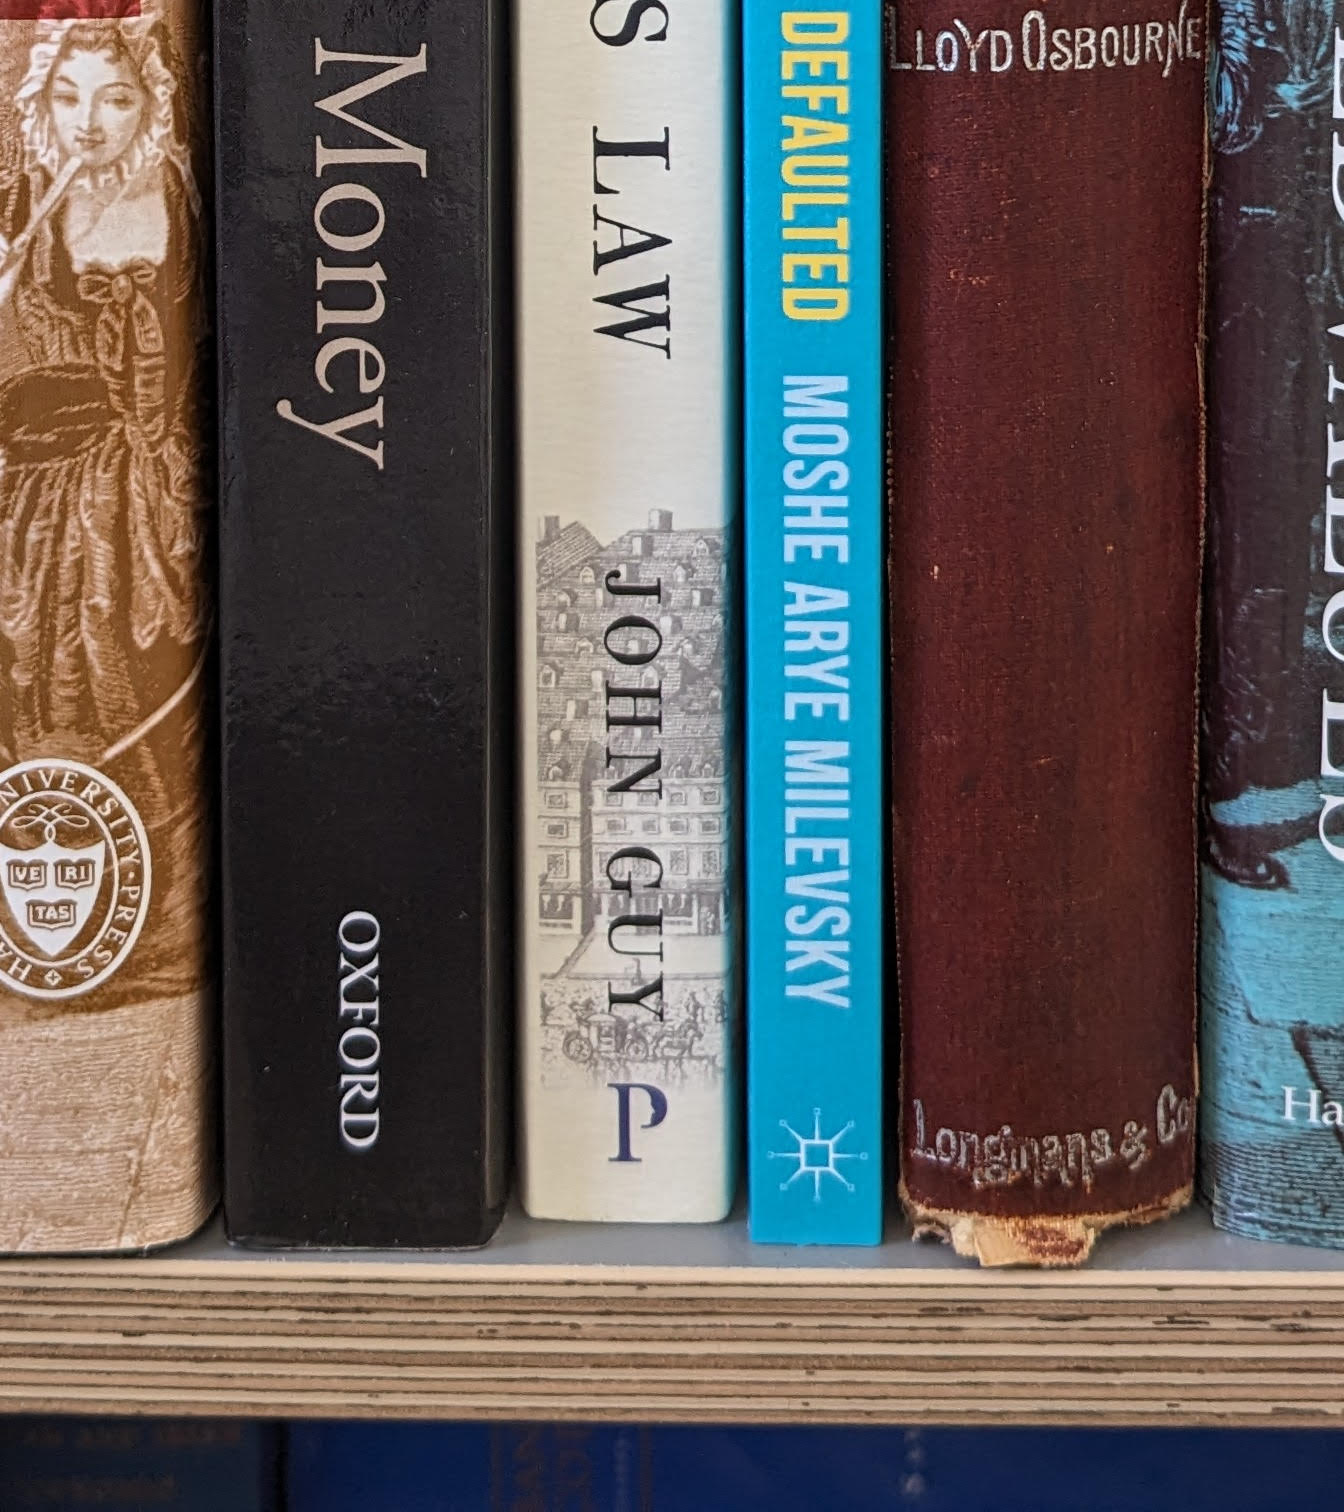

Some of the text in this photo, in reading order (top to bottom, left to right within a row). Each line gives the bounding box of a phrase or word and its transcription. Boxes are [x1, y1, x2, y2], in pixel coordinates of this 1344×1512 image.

[885, 0, 1203, 78] LLOYD OSBOURNE
[276, 39, 428, 471] Money
[591, 124, 672, 360] LAW
[780, 11, 851, 322] DEFAULTED
[601, 569, 665, 1024] JOHN GUY
[782, 374, 853, 1010] MOSHE ARYE MILEVSKY
[14, 866, 87, 881] VE RI
[35, 905, 70, 920] TAS
[76, 885, 141, 979] PRESS
[336, 909, 382, 1150] OXFORD
[1119, 1120, 1153, 1169] &
